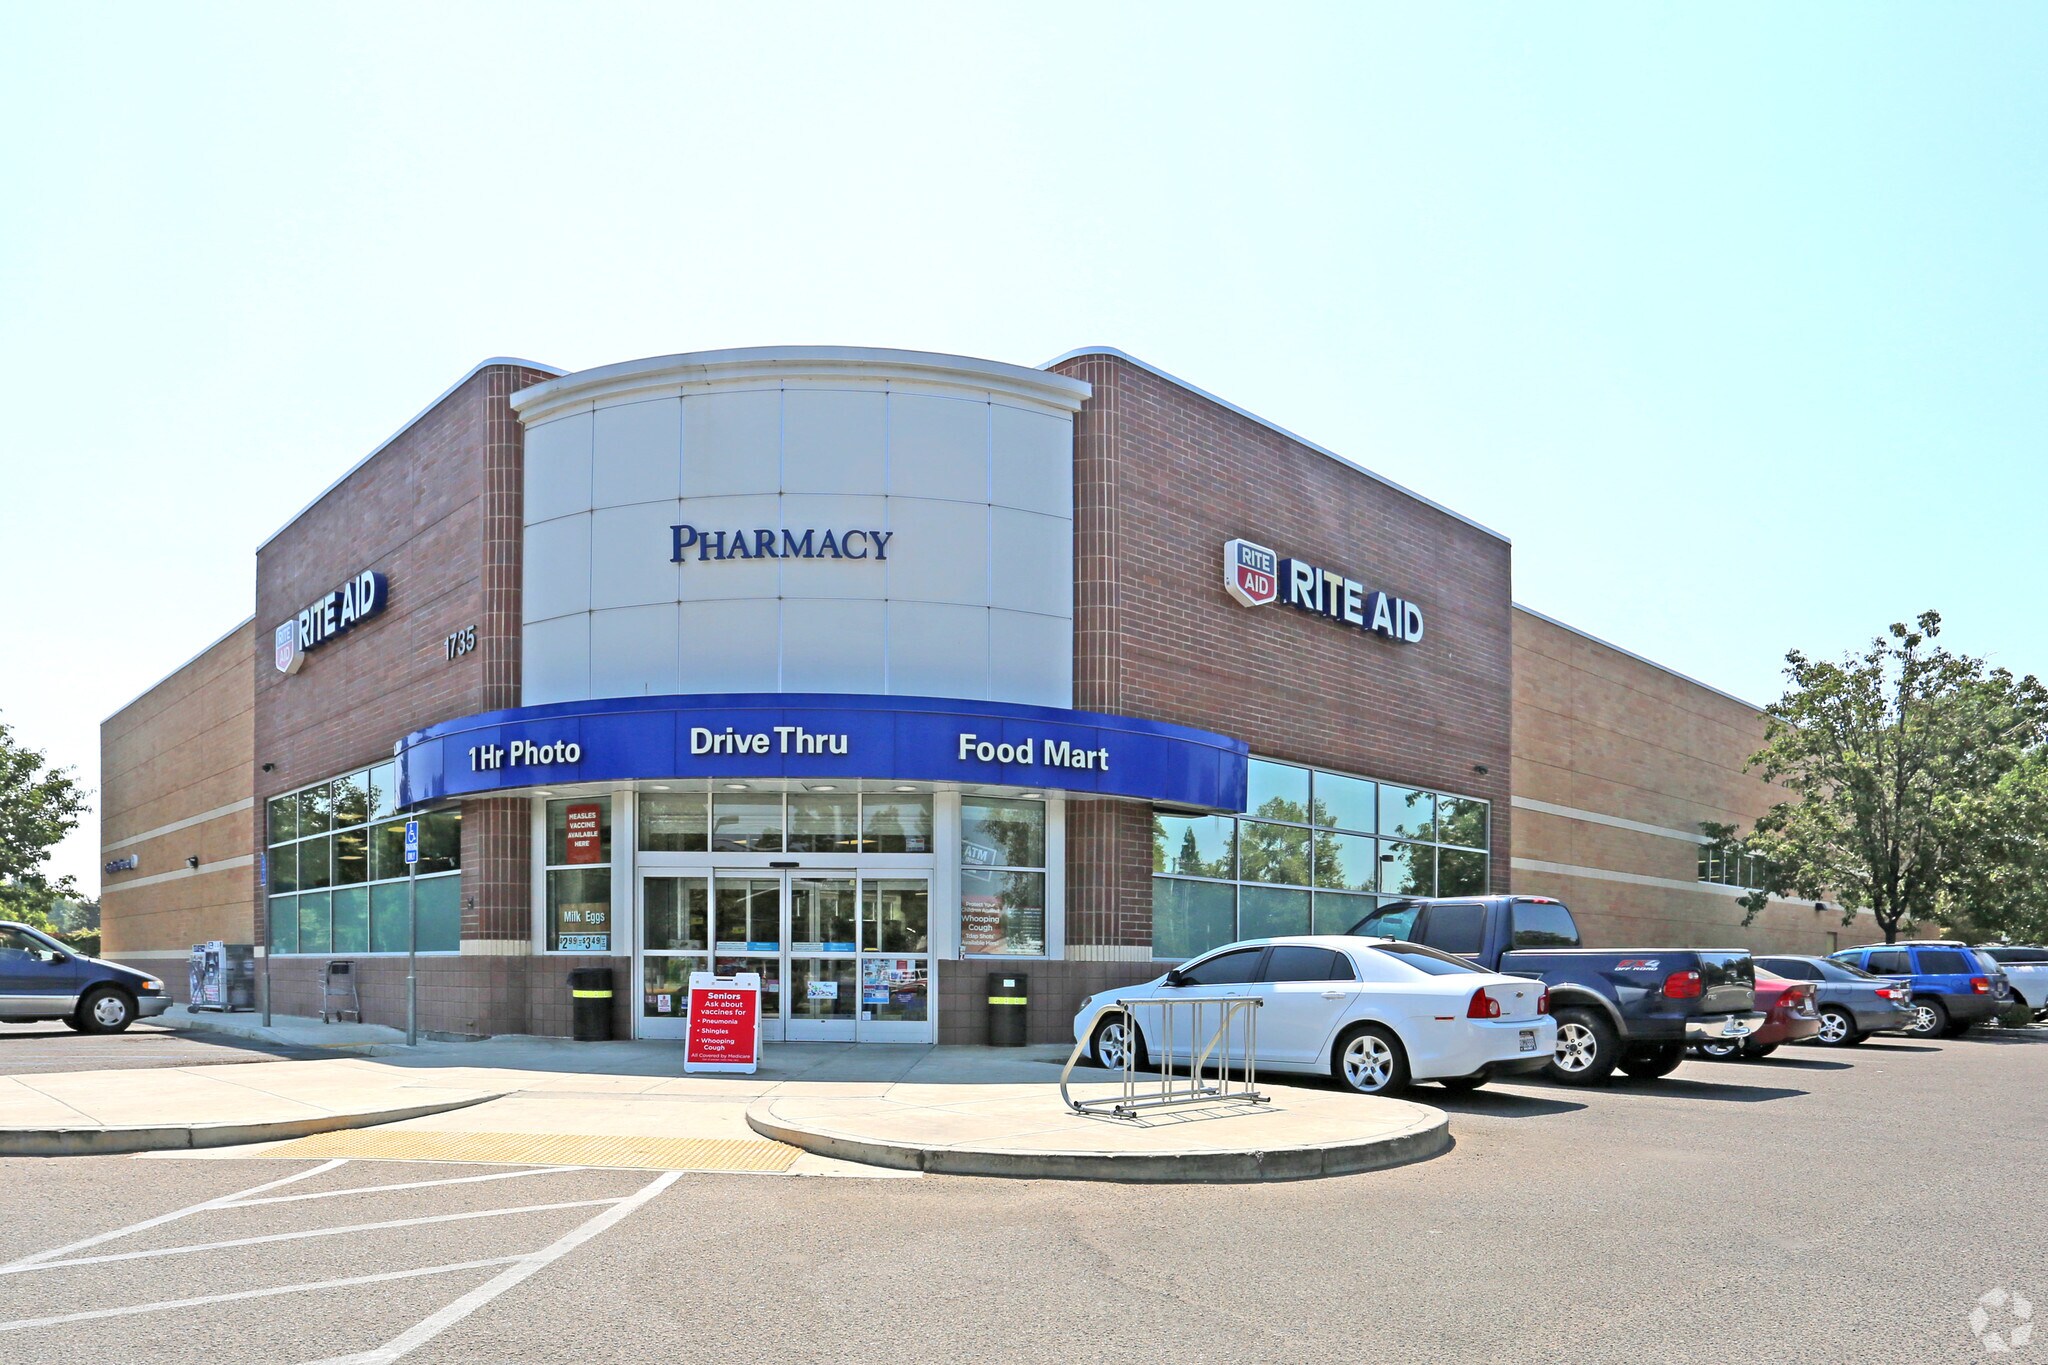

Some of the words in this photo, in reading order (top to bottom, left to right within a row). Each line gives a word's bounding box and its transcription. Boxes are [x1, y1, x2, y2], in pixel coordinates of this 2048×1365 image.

[670, 524, 893, 563] PHARMACY
[1242, 546, 1271, 572] RITE
[1244, 572, 1269, 595] AID
[298, 591, 336, 651] RITE
[340, 569, 376, 628] AID
[1290, 558, 1364, 625] RITE
[1371, 591, 1425, 644] AID
[443, 624, 476, 661] 1735
[690, 726, 770, 755] Drive
[773, 726, 848, 755] Thru
[958, 733, 1034, 765] Food
[1044, 739, 1109, 771] Mart
[468, 747, 477, 772] 1
[480, 744, 504, 769] Hr
[510, 739, 581, 767] Photo
[568, 830, 598, 838] AVAILABLE
[964, 846, 988, 861] ATM
[564, 910, 582, 923] Milk
[585, 910, 605, 925] Eggs
[961, 915, 1000, 924] Whooping
[968, 924, 993, 932] Cough
